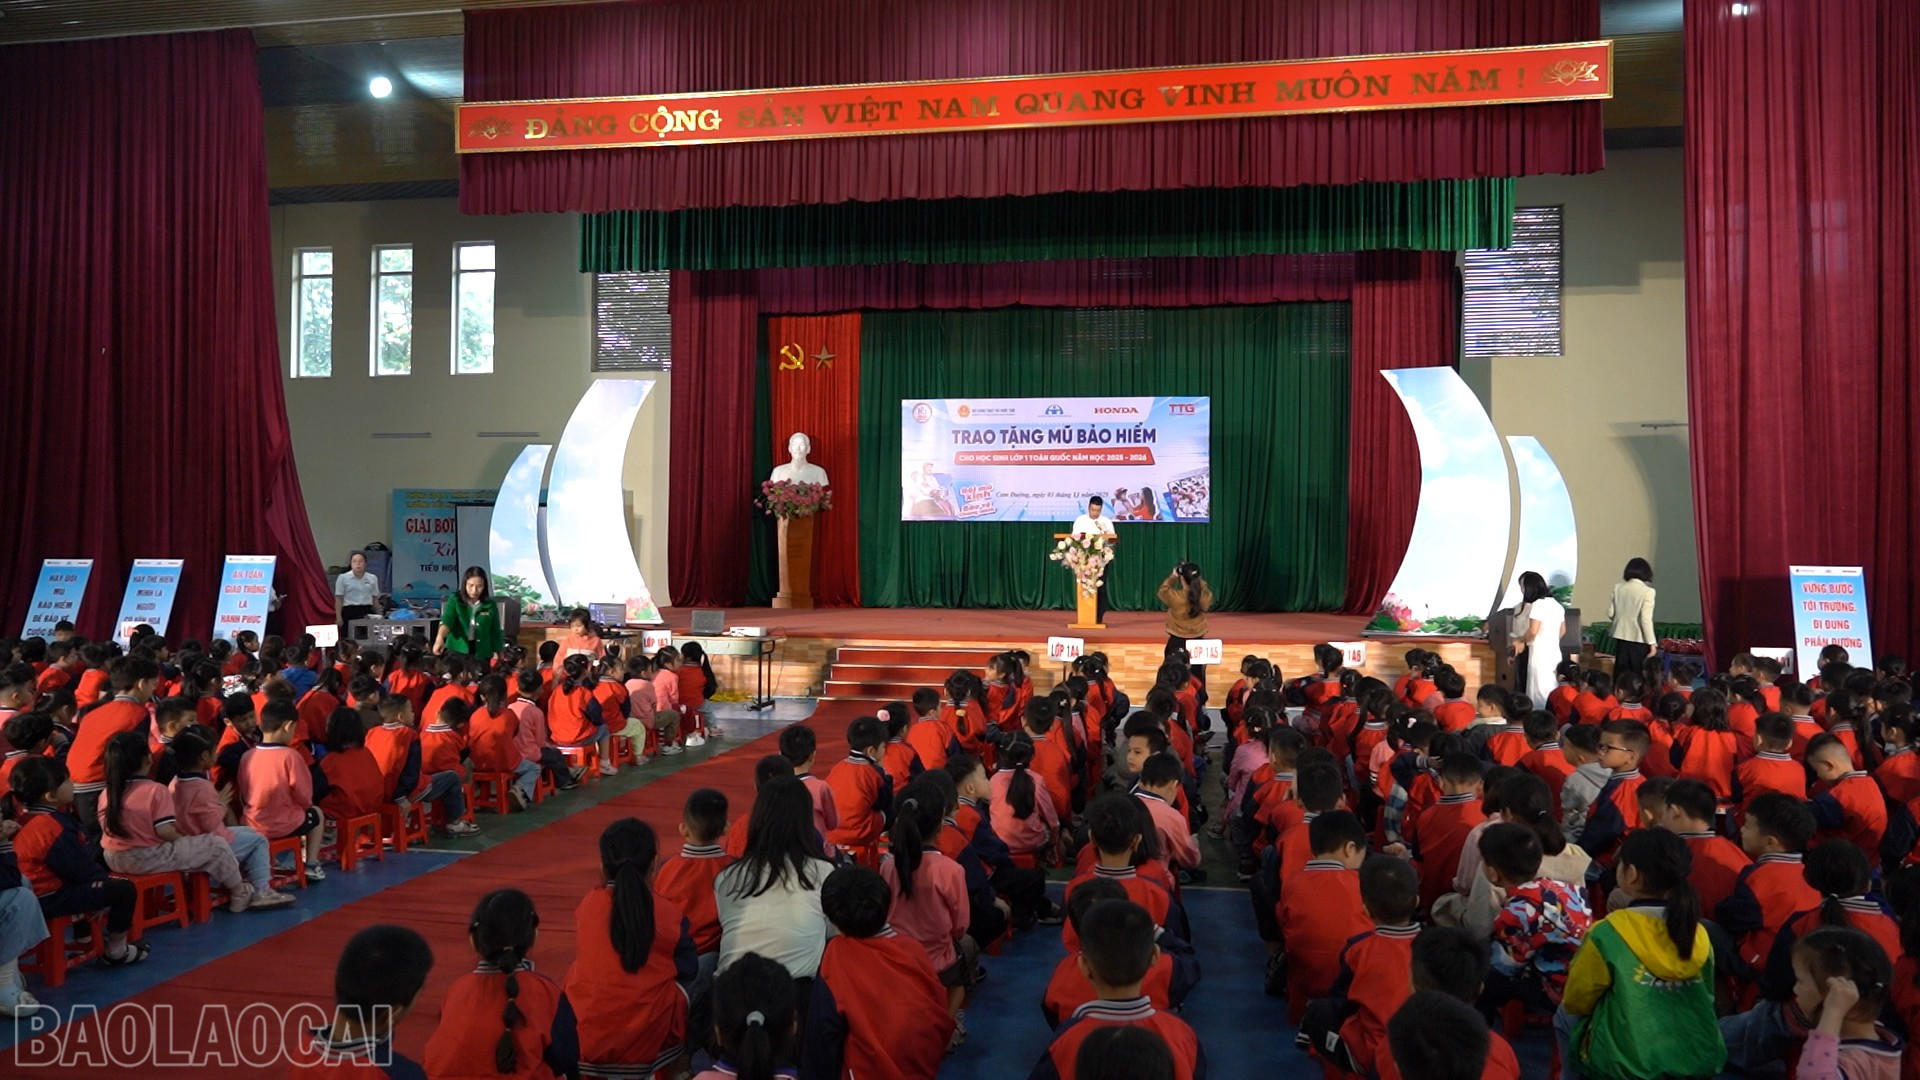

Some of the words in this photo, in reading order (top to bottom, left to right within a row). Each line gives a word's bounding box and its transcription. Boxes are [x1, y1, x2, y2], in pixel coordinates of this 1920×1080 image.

[524, 107, 618, 139] ĐẢNG
[629, 105, 722, 138] CỘNG
[737, 97, 805, 129] SẢN
[820, 95, 902, 127] VIỆT
[918, 95, 1000, 121] NAM
[1014, 88, 1146, 115] QUANG
[1158, 81, 1257, 108] VINH
[1275, 69, 1391, 102] MUÔN
[1411, 64, 1501, 95] NĂM
[1517, 68, 1525, 89] !
[1169, 403, 1195, 413] TTG
[952, 429, 996, 445] TRAO
[1000, 425, 1044, 449] TẶNG
[1048, 425, 1073, 444] MŨ
[1077, 424, 1112, 444] BẢO
[1116, 421, 1157, 444] HIỂM
[405, 512, 431, 533] GIẢI
